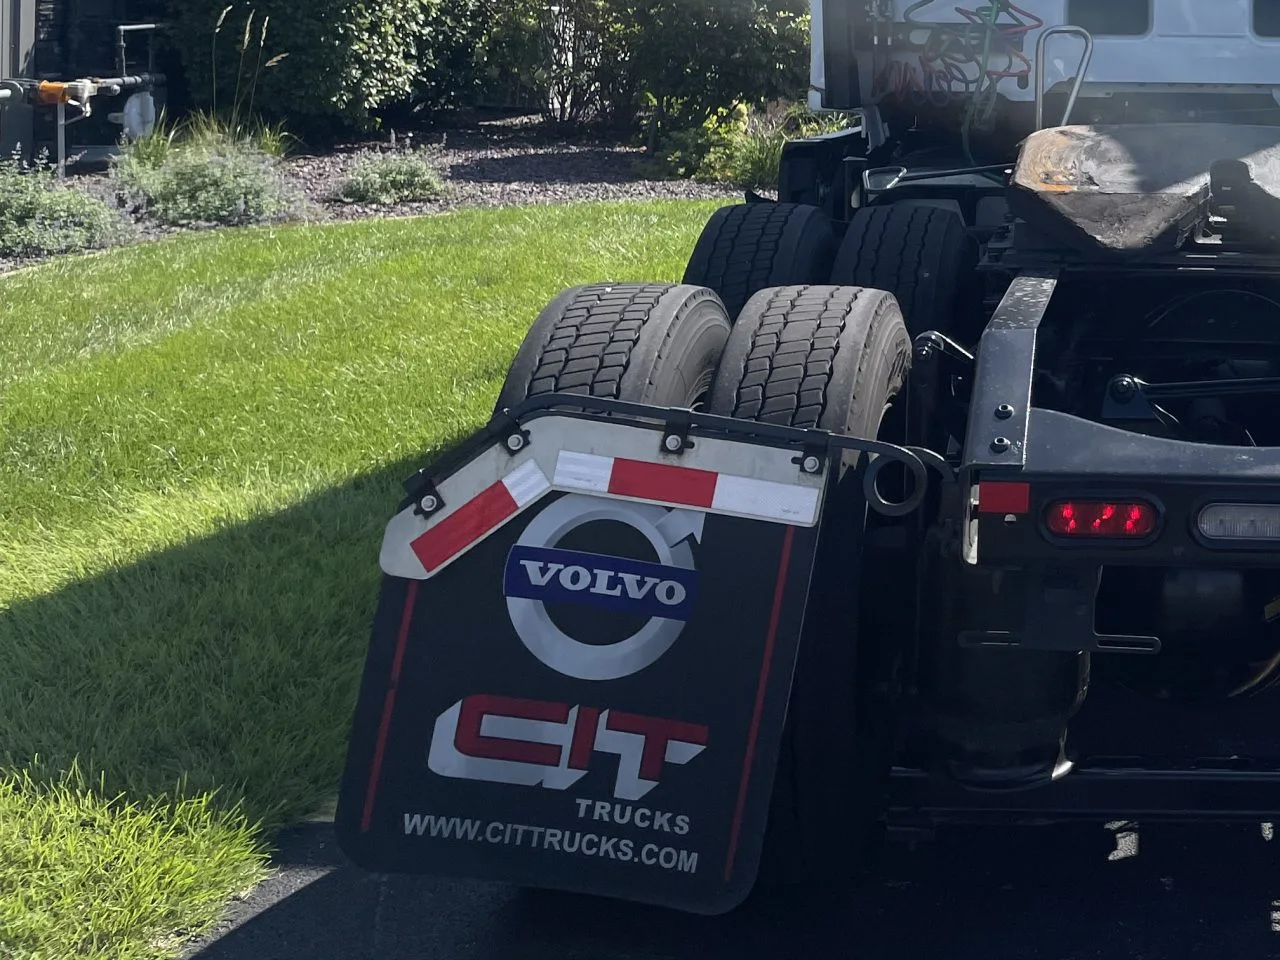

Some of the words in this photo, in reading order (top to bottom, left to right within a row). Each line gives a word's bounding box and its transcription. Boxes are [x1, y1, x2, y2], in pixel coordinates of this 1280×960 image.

[518, 558, 687, 607] VOLVO
[427, 693, 709, 801] CIT
[403, 812, 699, 874] WWW.CITTRUCKS.COM
[574, 797, 691, 835] TRUCKS
